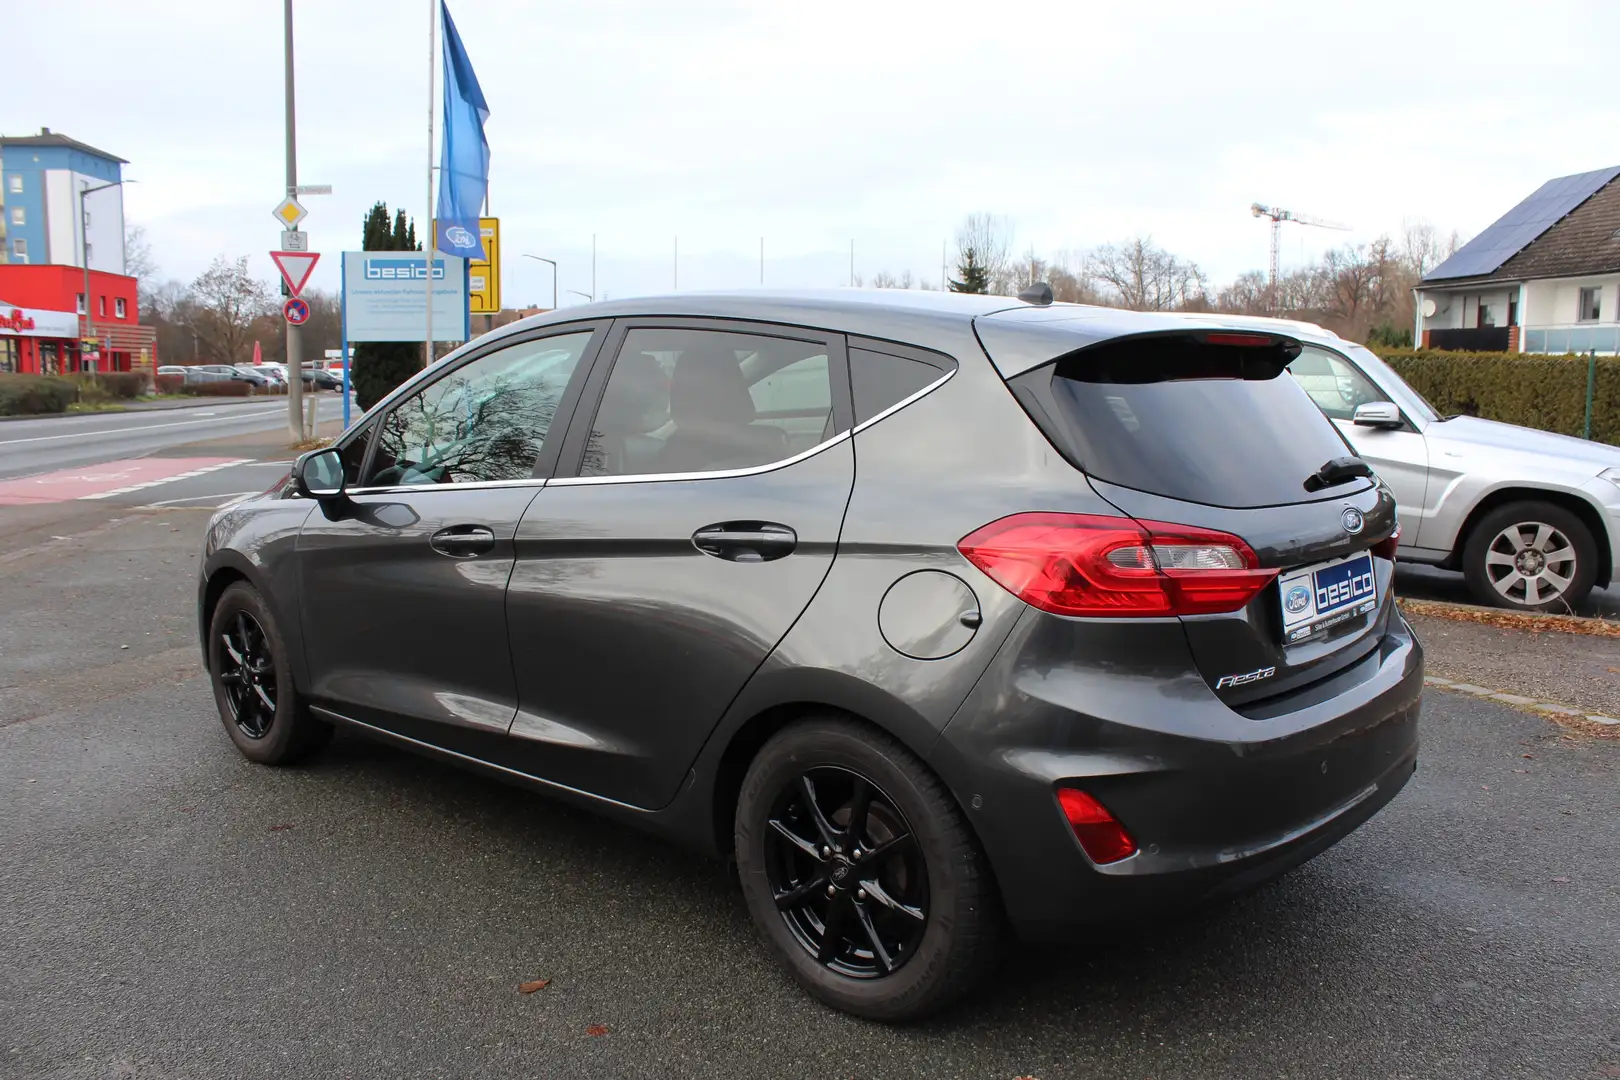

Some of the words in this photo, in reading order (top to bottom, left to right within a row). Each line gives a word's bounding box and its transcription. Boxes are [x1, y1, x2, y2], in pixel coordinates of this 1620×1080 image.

[366, 259, 444, 279] besico
[1288, 590, 1308, 611] Ford
[1316, 570, 1373, 609] besico
[1216, 666, 1276, 690] Fiesta
